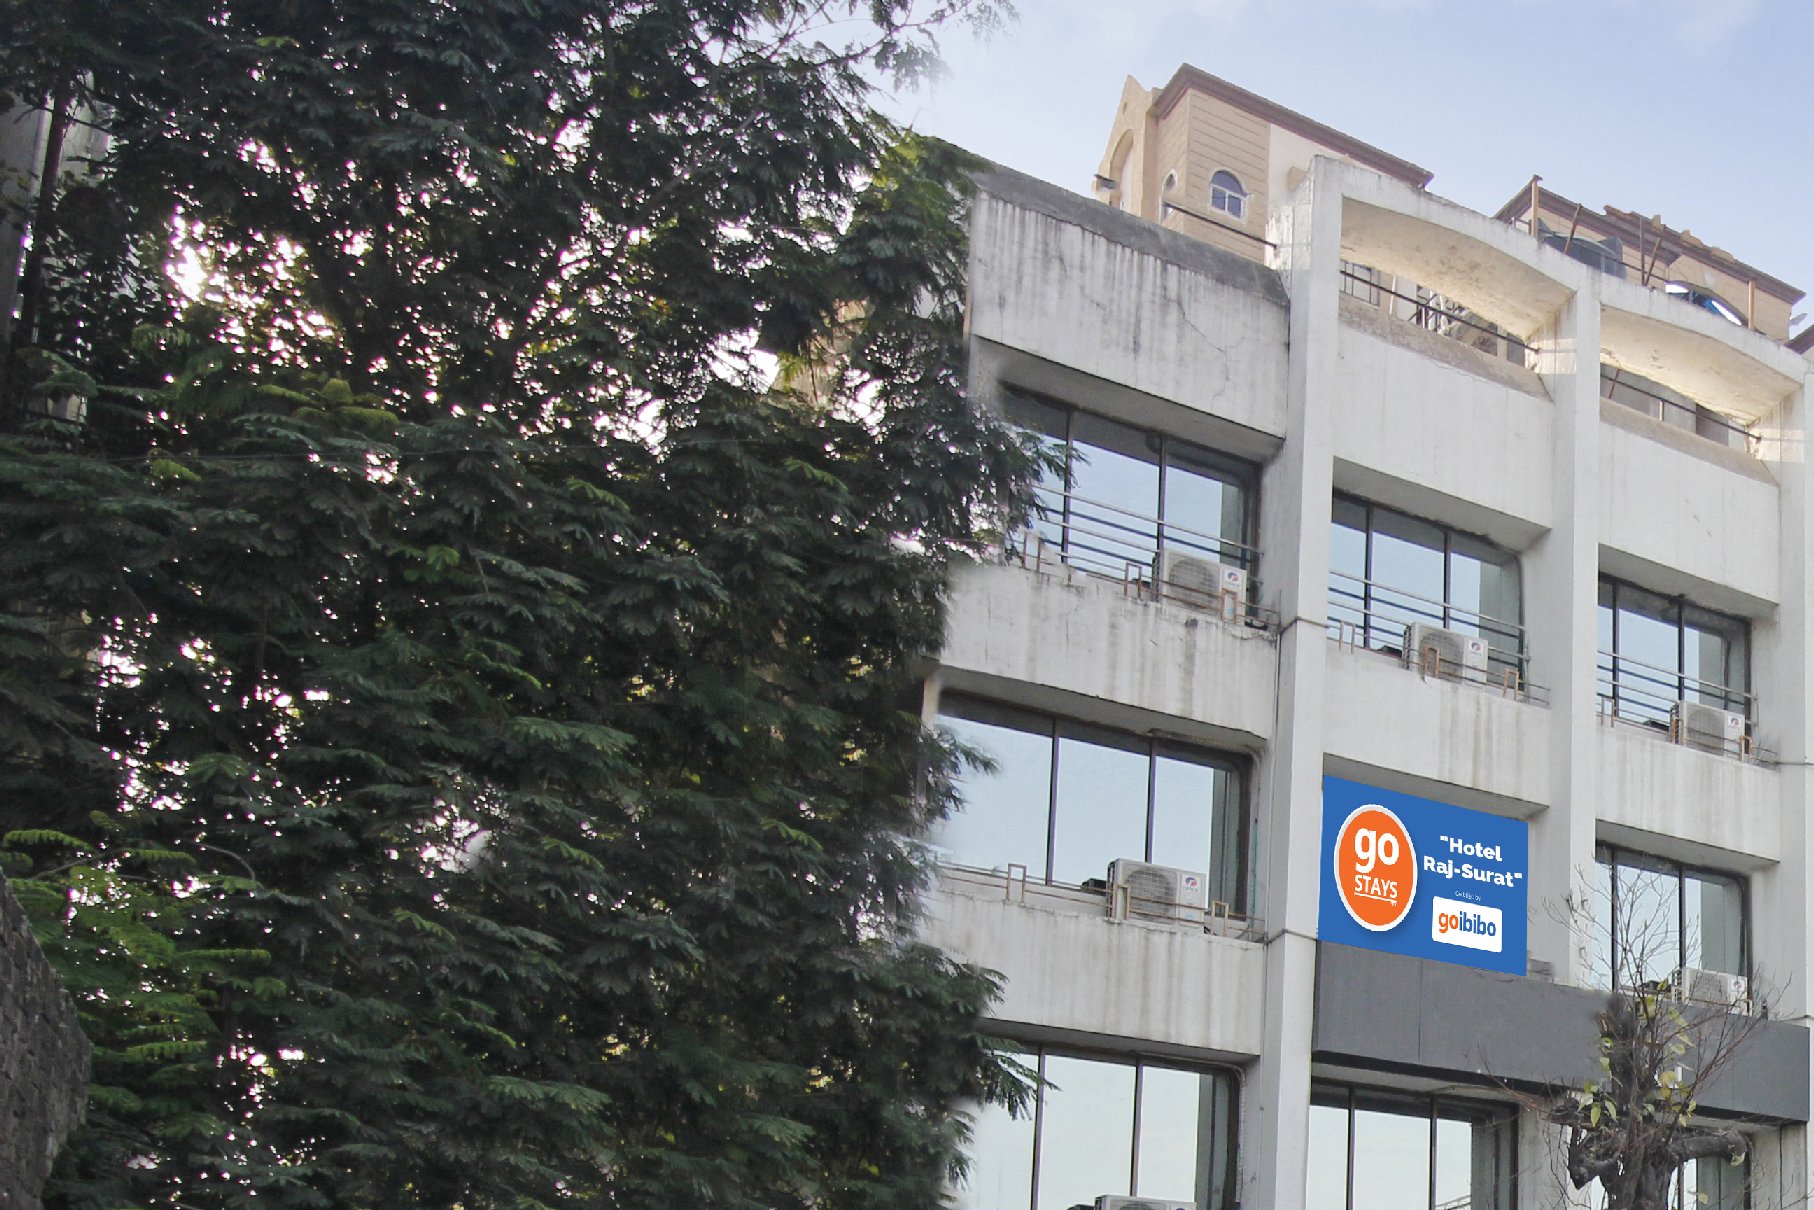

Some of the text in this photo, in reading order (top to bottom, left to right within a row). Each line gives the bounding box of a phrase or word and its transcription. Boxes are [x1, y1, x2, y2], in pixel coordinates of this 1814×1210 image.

[1355, 828, 1399, 873] go
[1354, 875, 1398, 898] STAYS
[1438, 911, 1497, 937] goibibo
